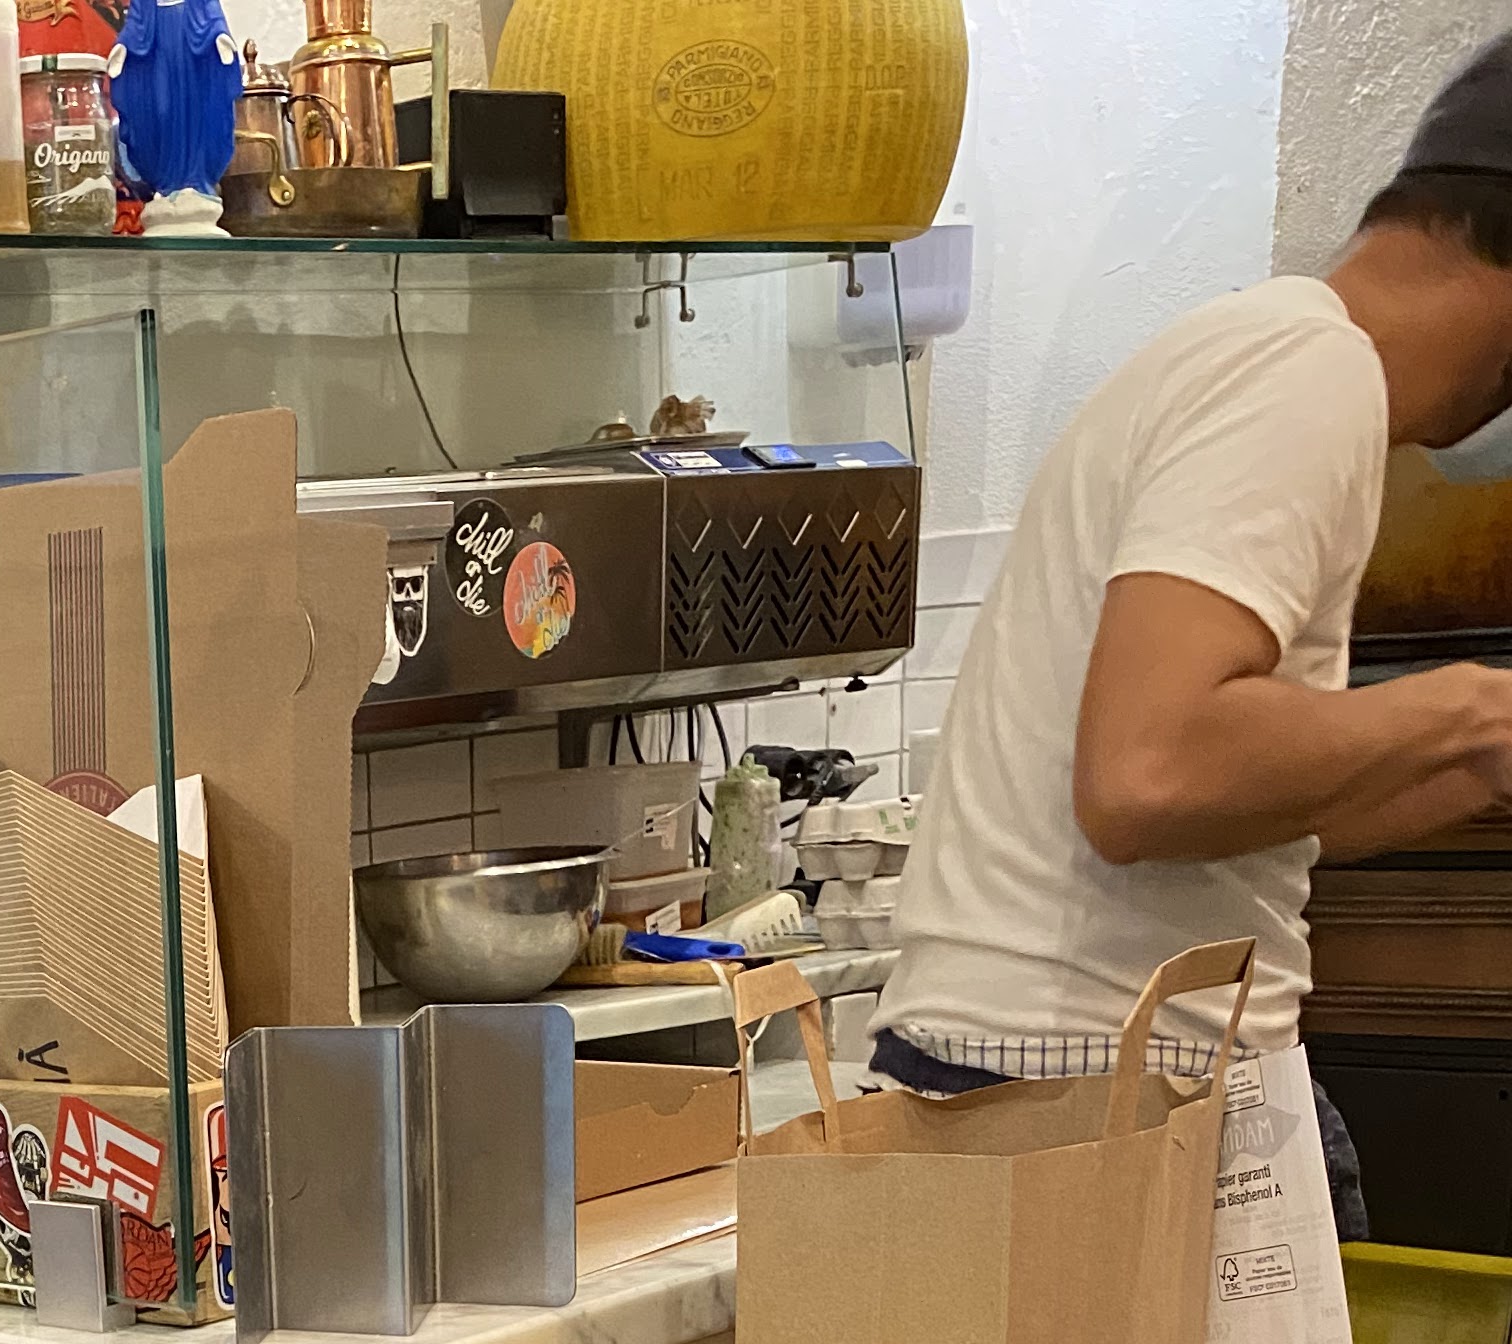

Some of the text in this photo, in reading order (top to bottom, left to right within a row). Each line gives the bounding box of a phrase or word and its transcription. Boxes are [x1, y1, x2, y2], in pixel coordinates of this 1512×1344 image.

[1217, 1164, 1272, 1192] apier garanti
[1228, 1182, 1284, 1208] Bisphenol A
[124, 1220, 171, 1248] RDAN
